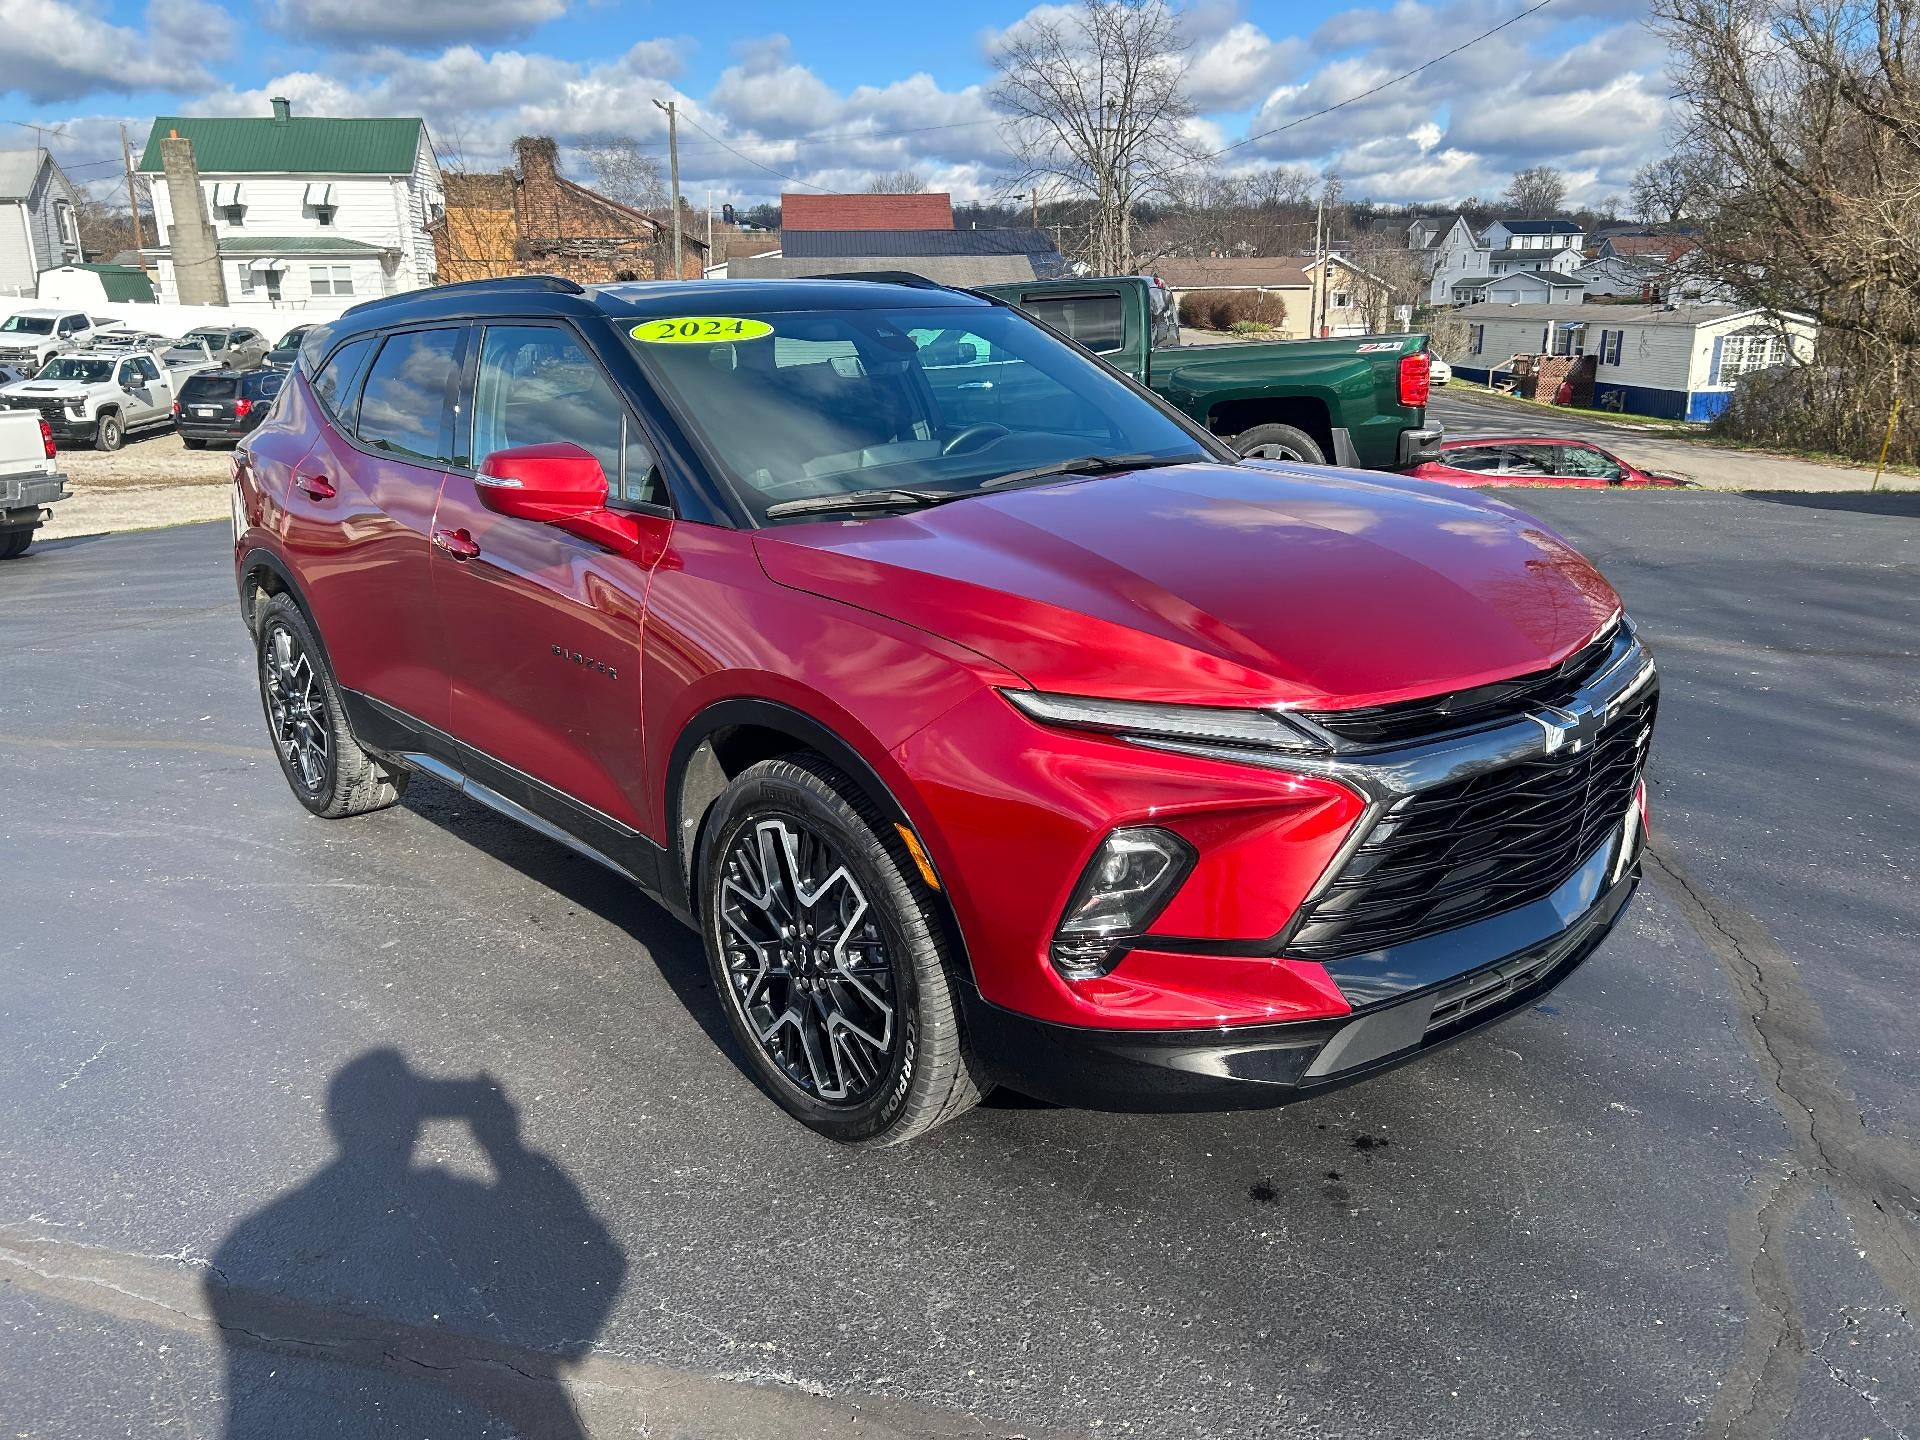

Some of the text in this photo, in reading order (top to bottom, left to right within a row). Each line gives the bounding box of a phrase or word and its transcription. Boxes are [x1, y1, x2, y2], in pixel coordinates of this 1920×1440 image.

[656, 320, 744, 339] 2024
[1355, 341, 1404, 353] Z71
[551, 643, 618, 680] BLAZER
[880, 1007, 917, 1122] SCORPION
